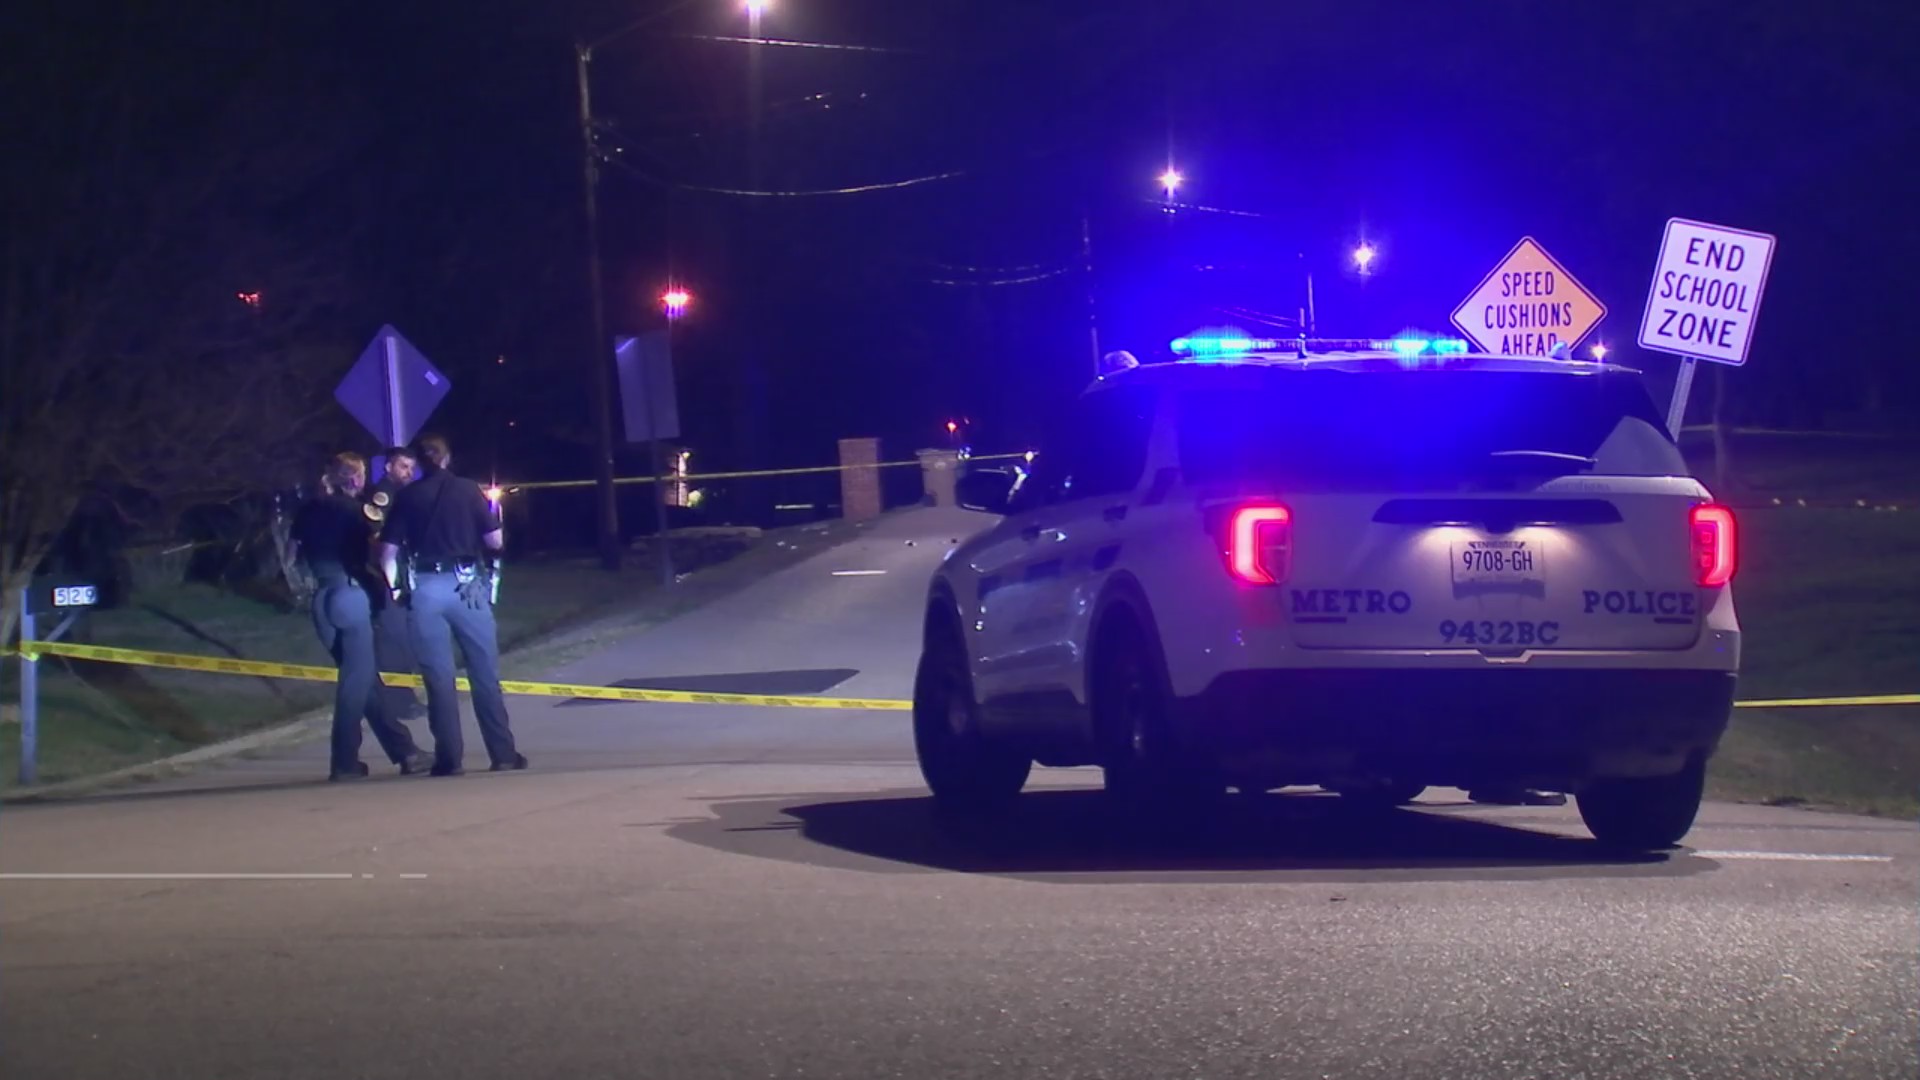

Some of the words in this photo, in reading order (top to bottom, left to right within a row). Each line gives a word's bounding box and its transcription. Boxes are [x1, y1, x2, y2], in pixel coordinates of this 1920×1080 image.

[1685, 237, 1745, 272] END
[1501, 271, 1555, 297] SPEED
[1660, 271, 1749, 313] SCHOOL
[1484, 302, 1572, 330] CUSHIONS
[1656, 309, 1737, 348] ZONE
[1501, 332, 1558, 357] AHEAD
[1462, 550, 1533, 572] 9708-GH
[56, 587, 96, 604] 529
[1291, 589, 1412, 615] METRO
[1582, 589, 1697, 616] POLICE
[1439, 619, 1560, 646] 9432BC
